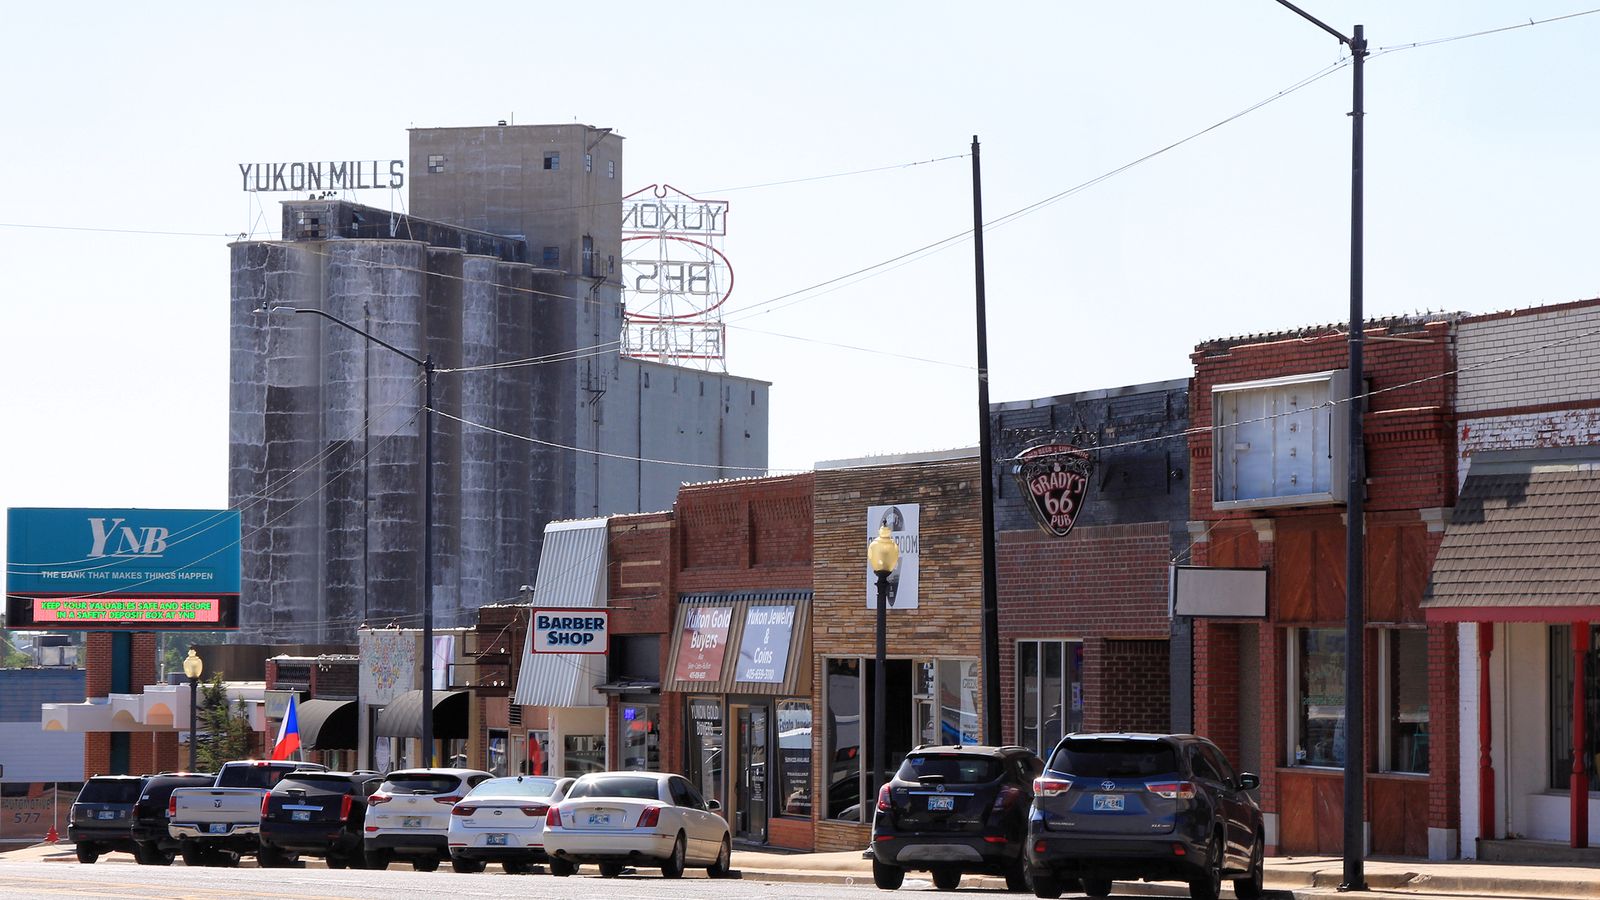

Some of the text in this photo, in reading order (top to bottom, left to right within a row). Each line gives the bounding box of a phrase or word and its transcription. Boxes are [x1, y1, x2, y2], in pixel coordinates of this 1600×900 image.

[239, 160, 404, 192] YUKON MILLS
[1031, 472, 1086, 495] GRADY'S
[1044, 490, 1073, 515] 66
[1050, 514, 1072, 527] PUB
[87, 518, 169, 558] YNB
[42, 571, 213, 580] THE BANK THAT MAKES THINGS HAPPEN
[41, 602, 211, 610] KEEP YOUR VALUABLES SAFE AND SECURE
[57, 611, 196, 619] IN A SAFETY DEPOSIT BOX AT YNB
[537, 616, 605, 630] BARBER
[686, 609, 731, 628] Yukon Gold
[747, 608, 795, 628] Yukon Jewelry
[547, 631, 594, 645] SHOP
[690, 631, 718, 652] Buyers
[763, 628, 770, 644] &
[753, 647, 773, 664] Coins
[691, 704, 719, 719] YUKON GOLD
[15, 812, 40, 823] 577
